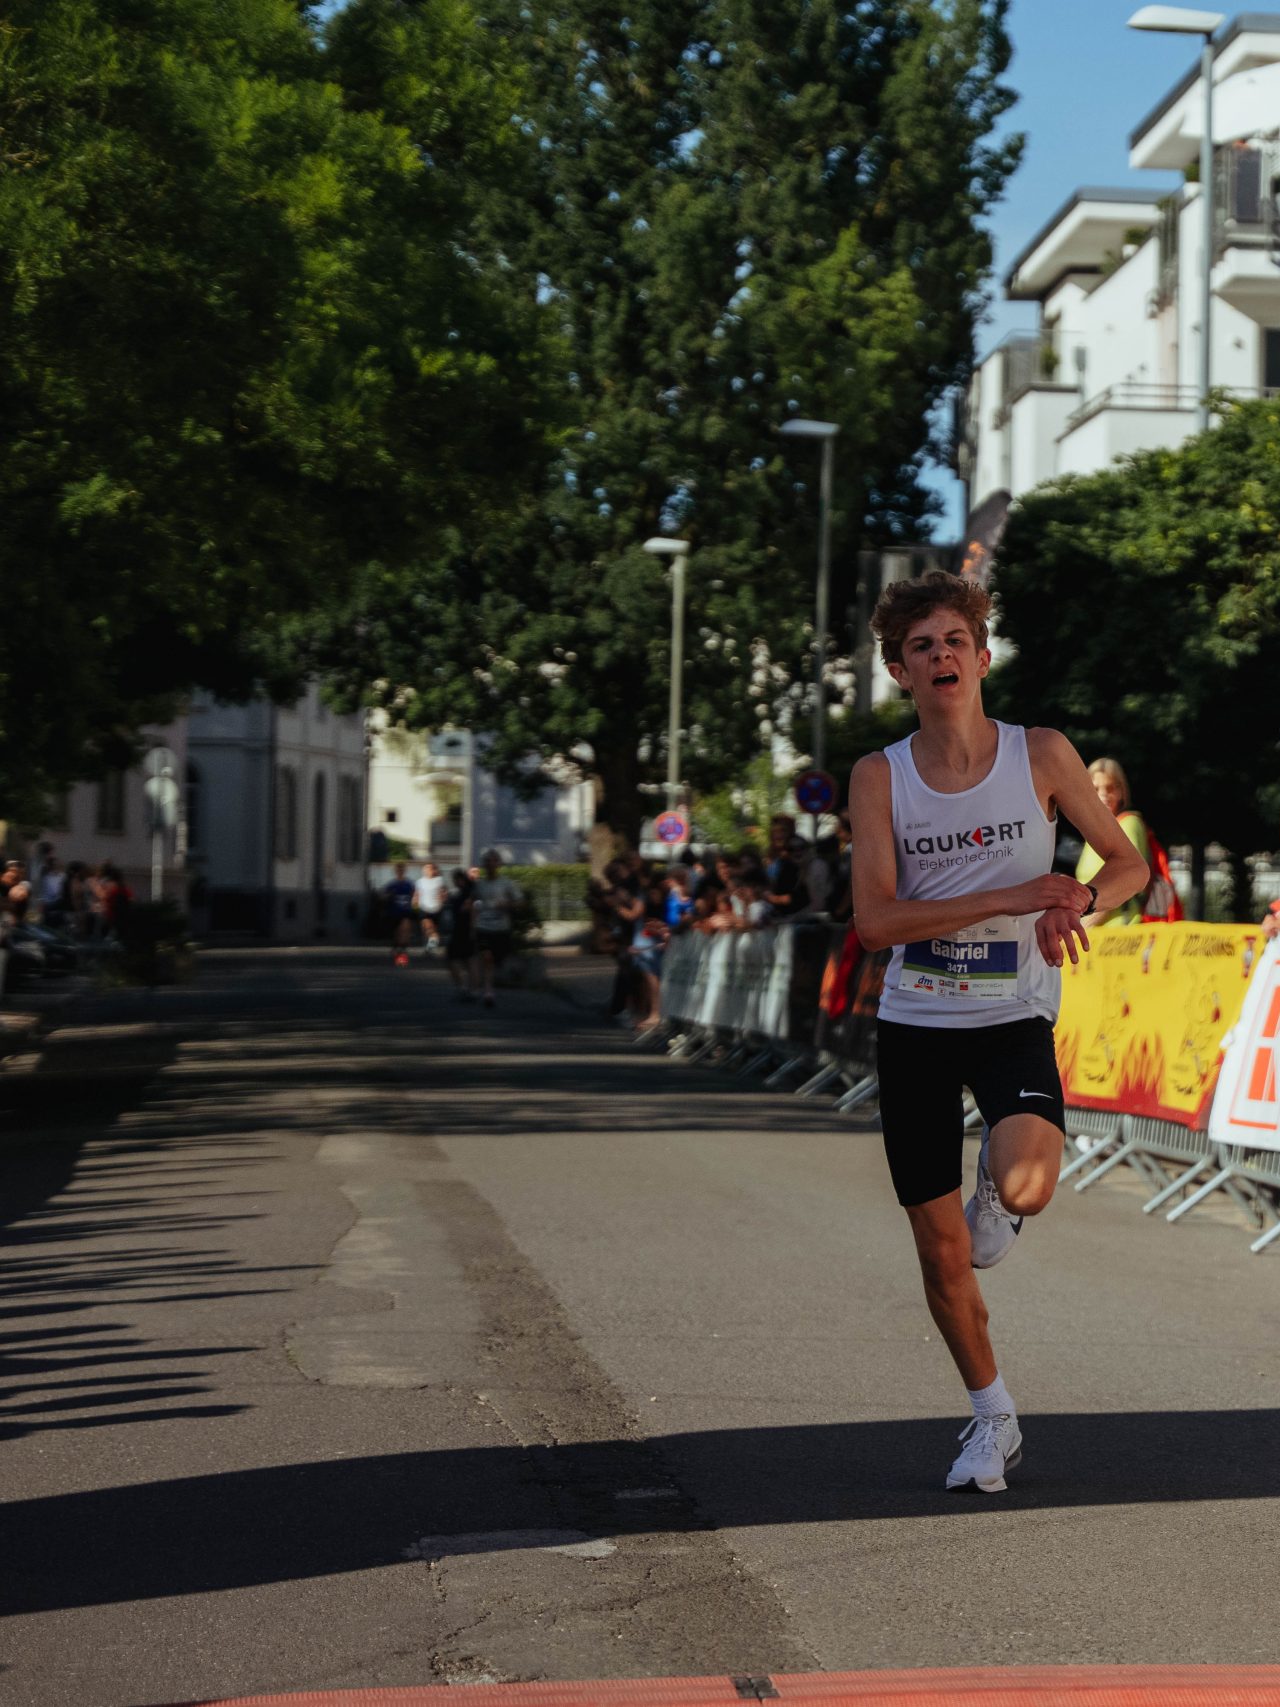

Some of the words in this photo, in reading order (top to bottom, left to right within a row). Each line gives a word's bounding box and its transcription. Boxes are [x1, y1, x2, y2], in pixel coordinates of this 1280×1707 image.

[918, 845, 1014, 871] Elektrotechnik
[930, 939, 989, 960] Gabriel
[946, 962, 968, 973] 3471
[917, 975, 933, 986] dm
